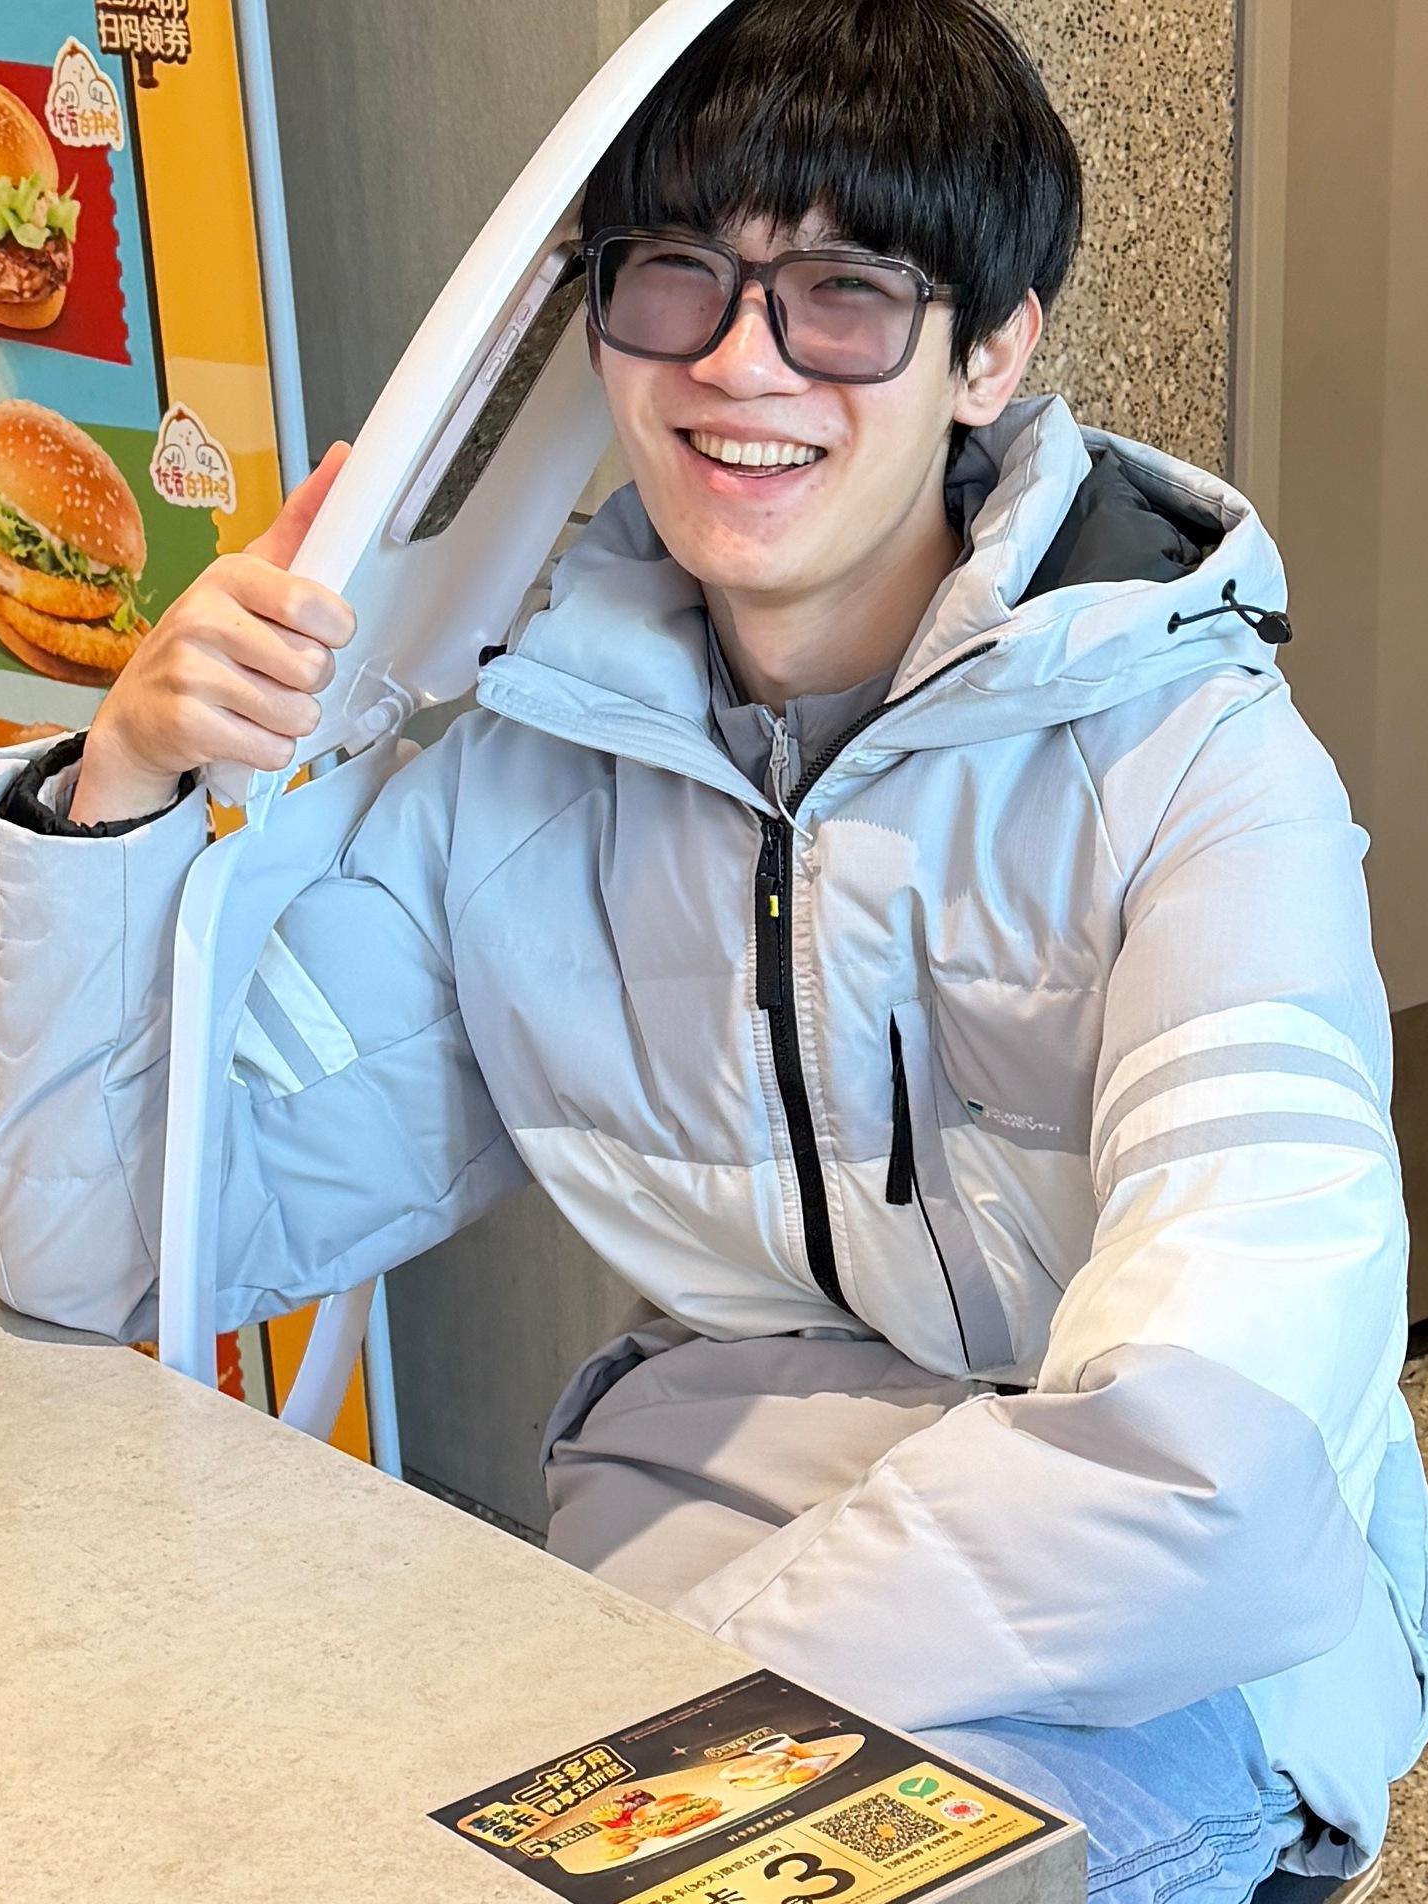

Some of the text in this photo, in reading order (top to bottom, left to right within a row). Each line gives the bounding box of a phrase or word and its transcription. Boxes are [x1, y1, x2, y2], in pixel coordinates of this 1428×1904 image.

[99, 10, 190, 59] 扫码领券
[763, 1852, 856, 1900] 3
